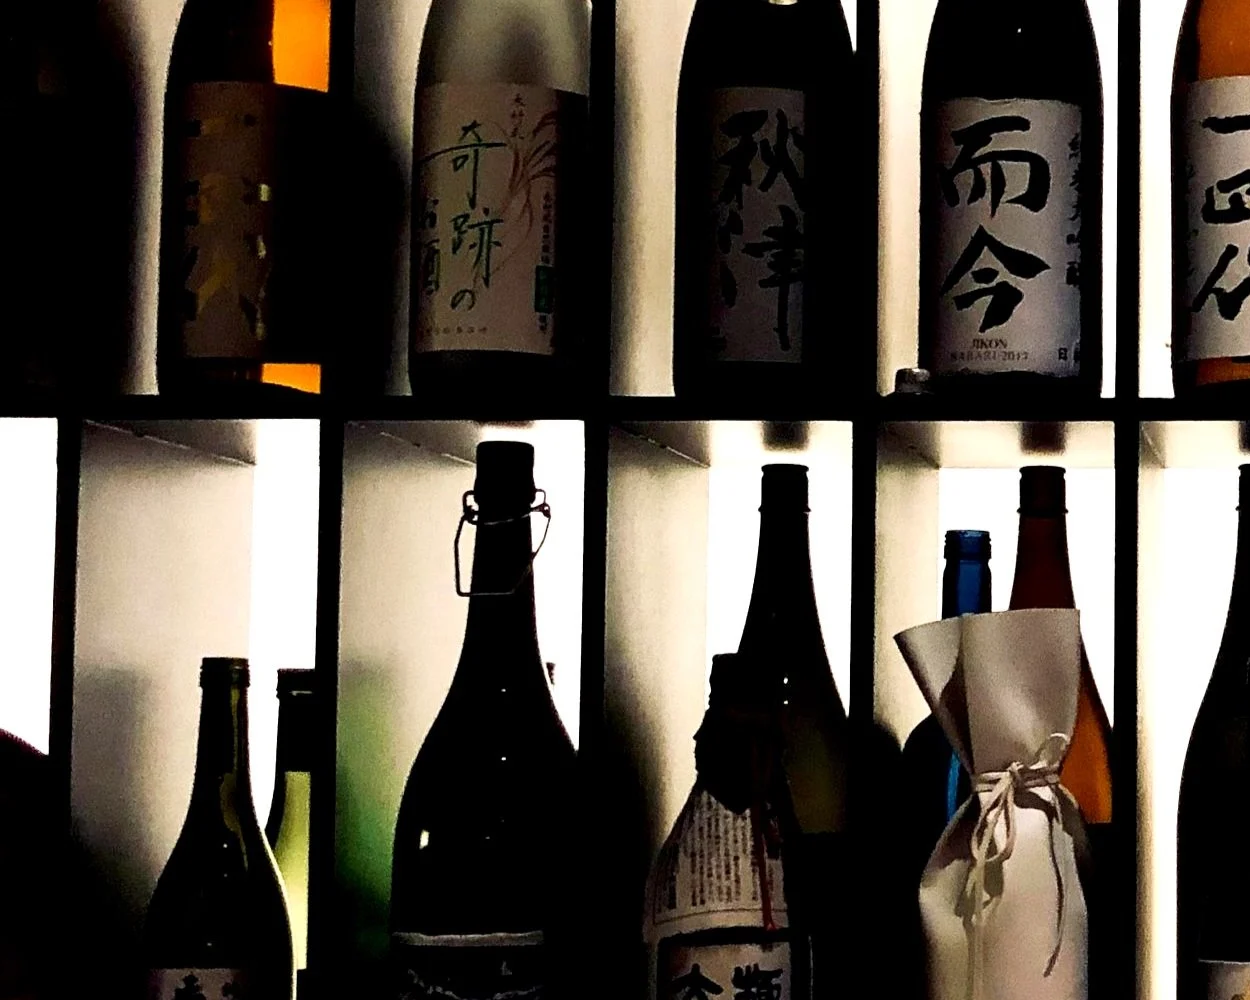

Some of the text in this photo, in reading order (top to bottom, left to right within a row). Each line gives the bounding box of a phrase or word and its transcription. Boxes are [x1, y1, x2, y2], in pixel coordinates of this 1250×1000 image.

[413, 118, 507, 312] 奇跡の
[939, 115, 1049, 334] 而今
